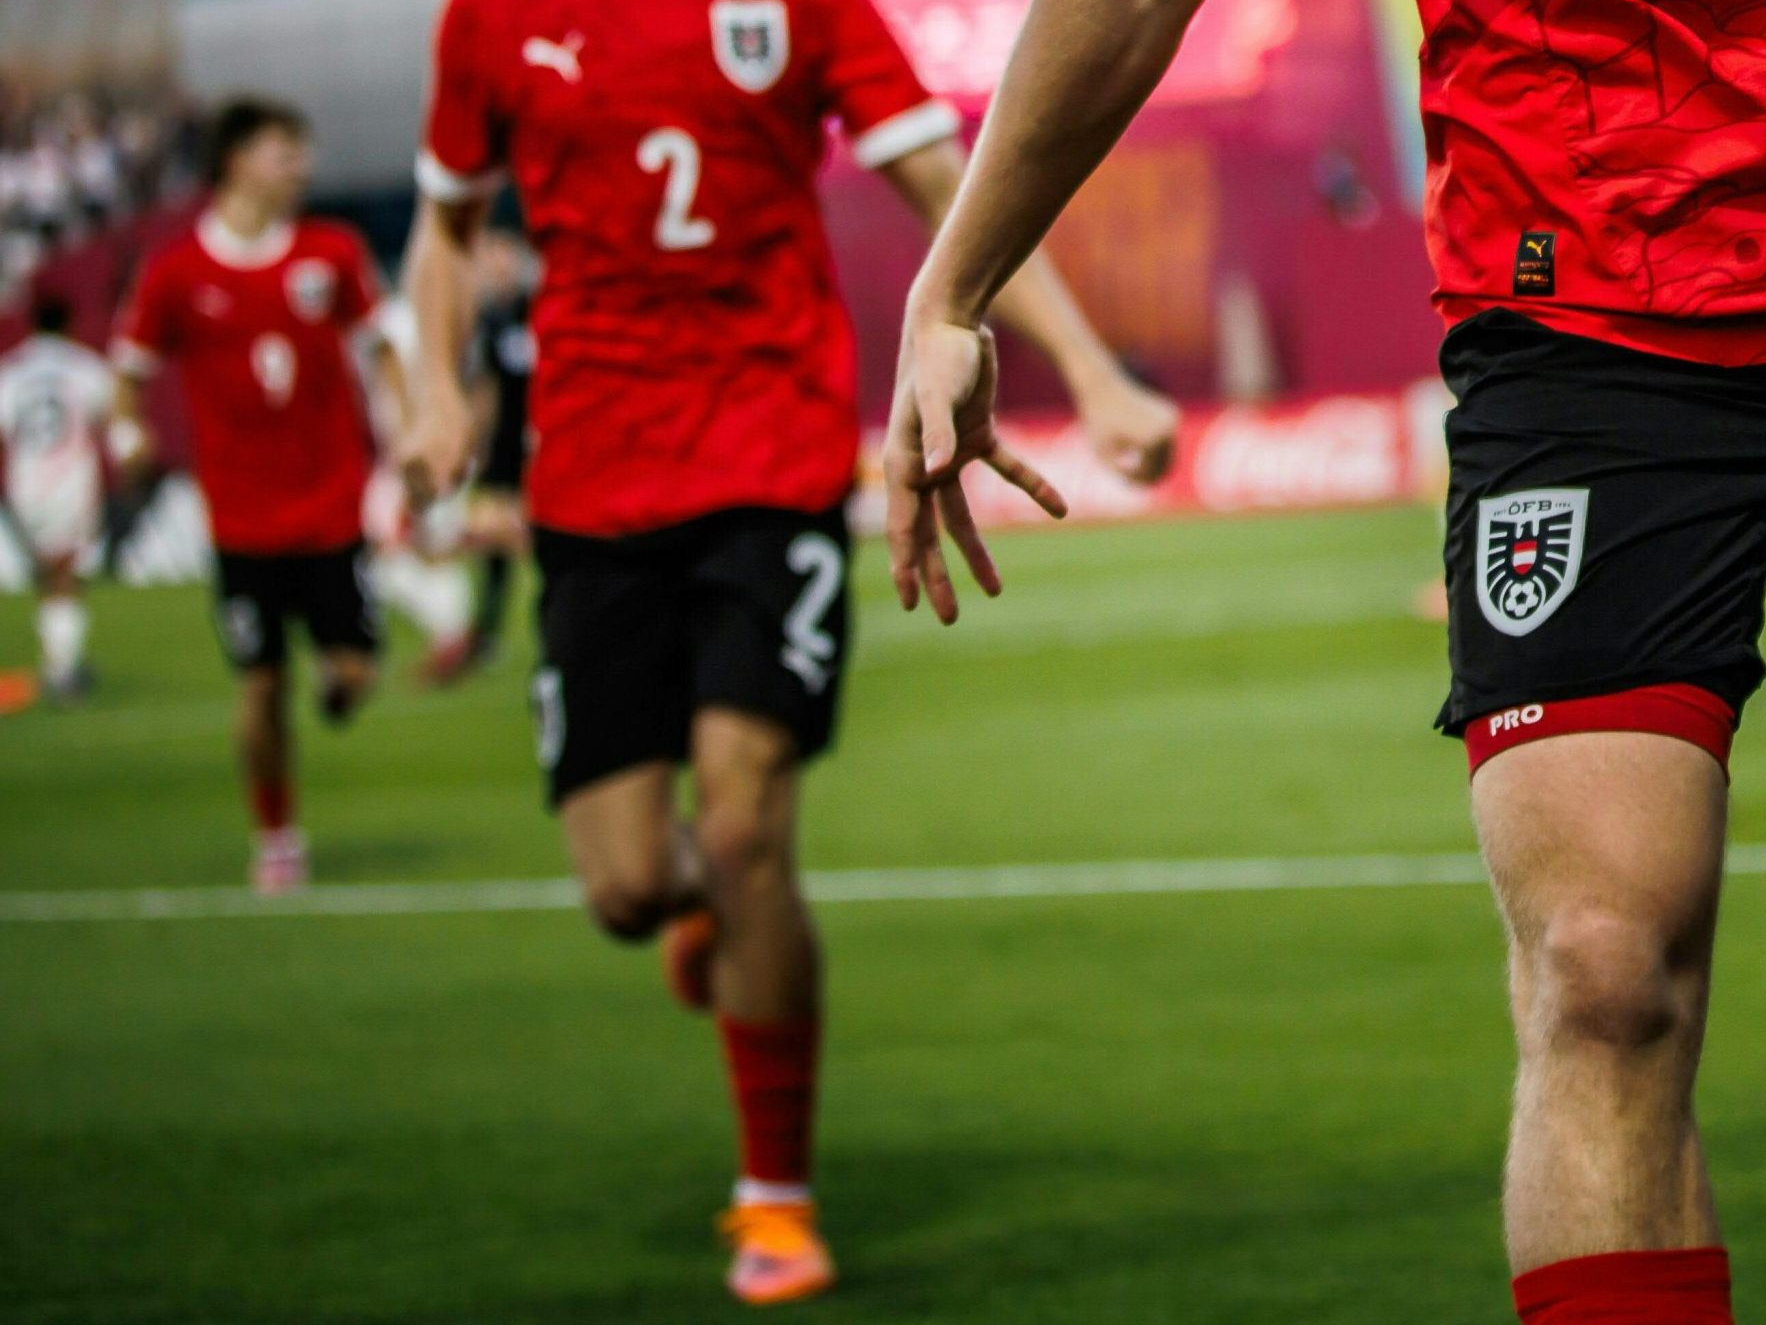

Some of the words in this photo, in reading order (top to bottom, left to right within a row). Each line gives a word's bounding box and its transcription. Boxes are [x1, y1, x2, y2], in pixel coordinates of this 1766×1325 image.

[637, 127, 717, 250] 2
[1508, 499, 1553, 516] ÖFB
[784, 532, 842, 660] 2
[1489, 704, 1543, 737] PRO
